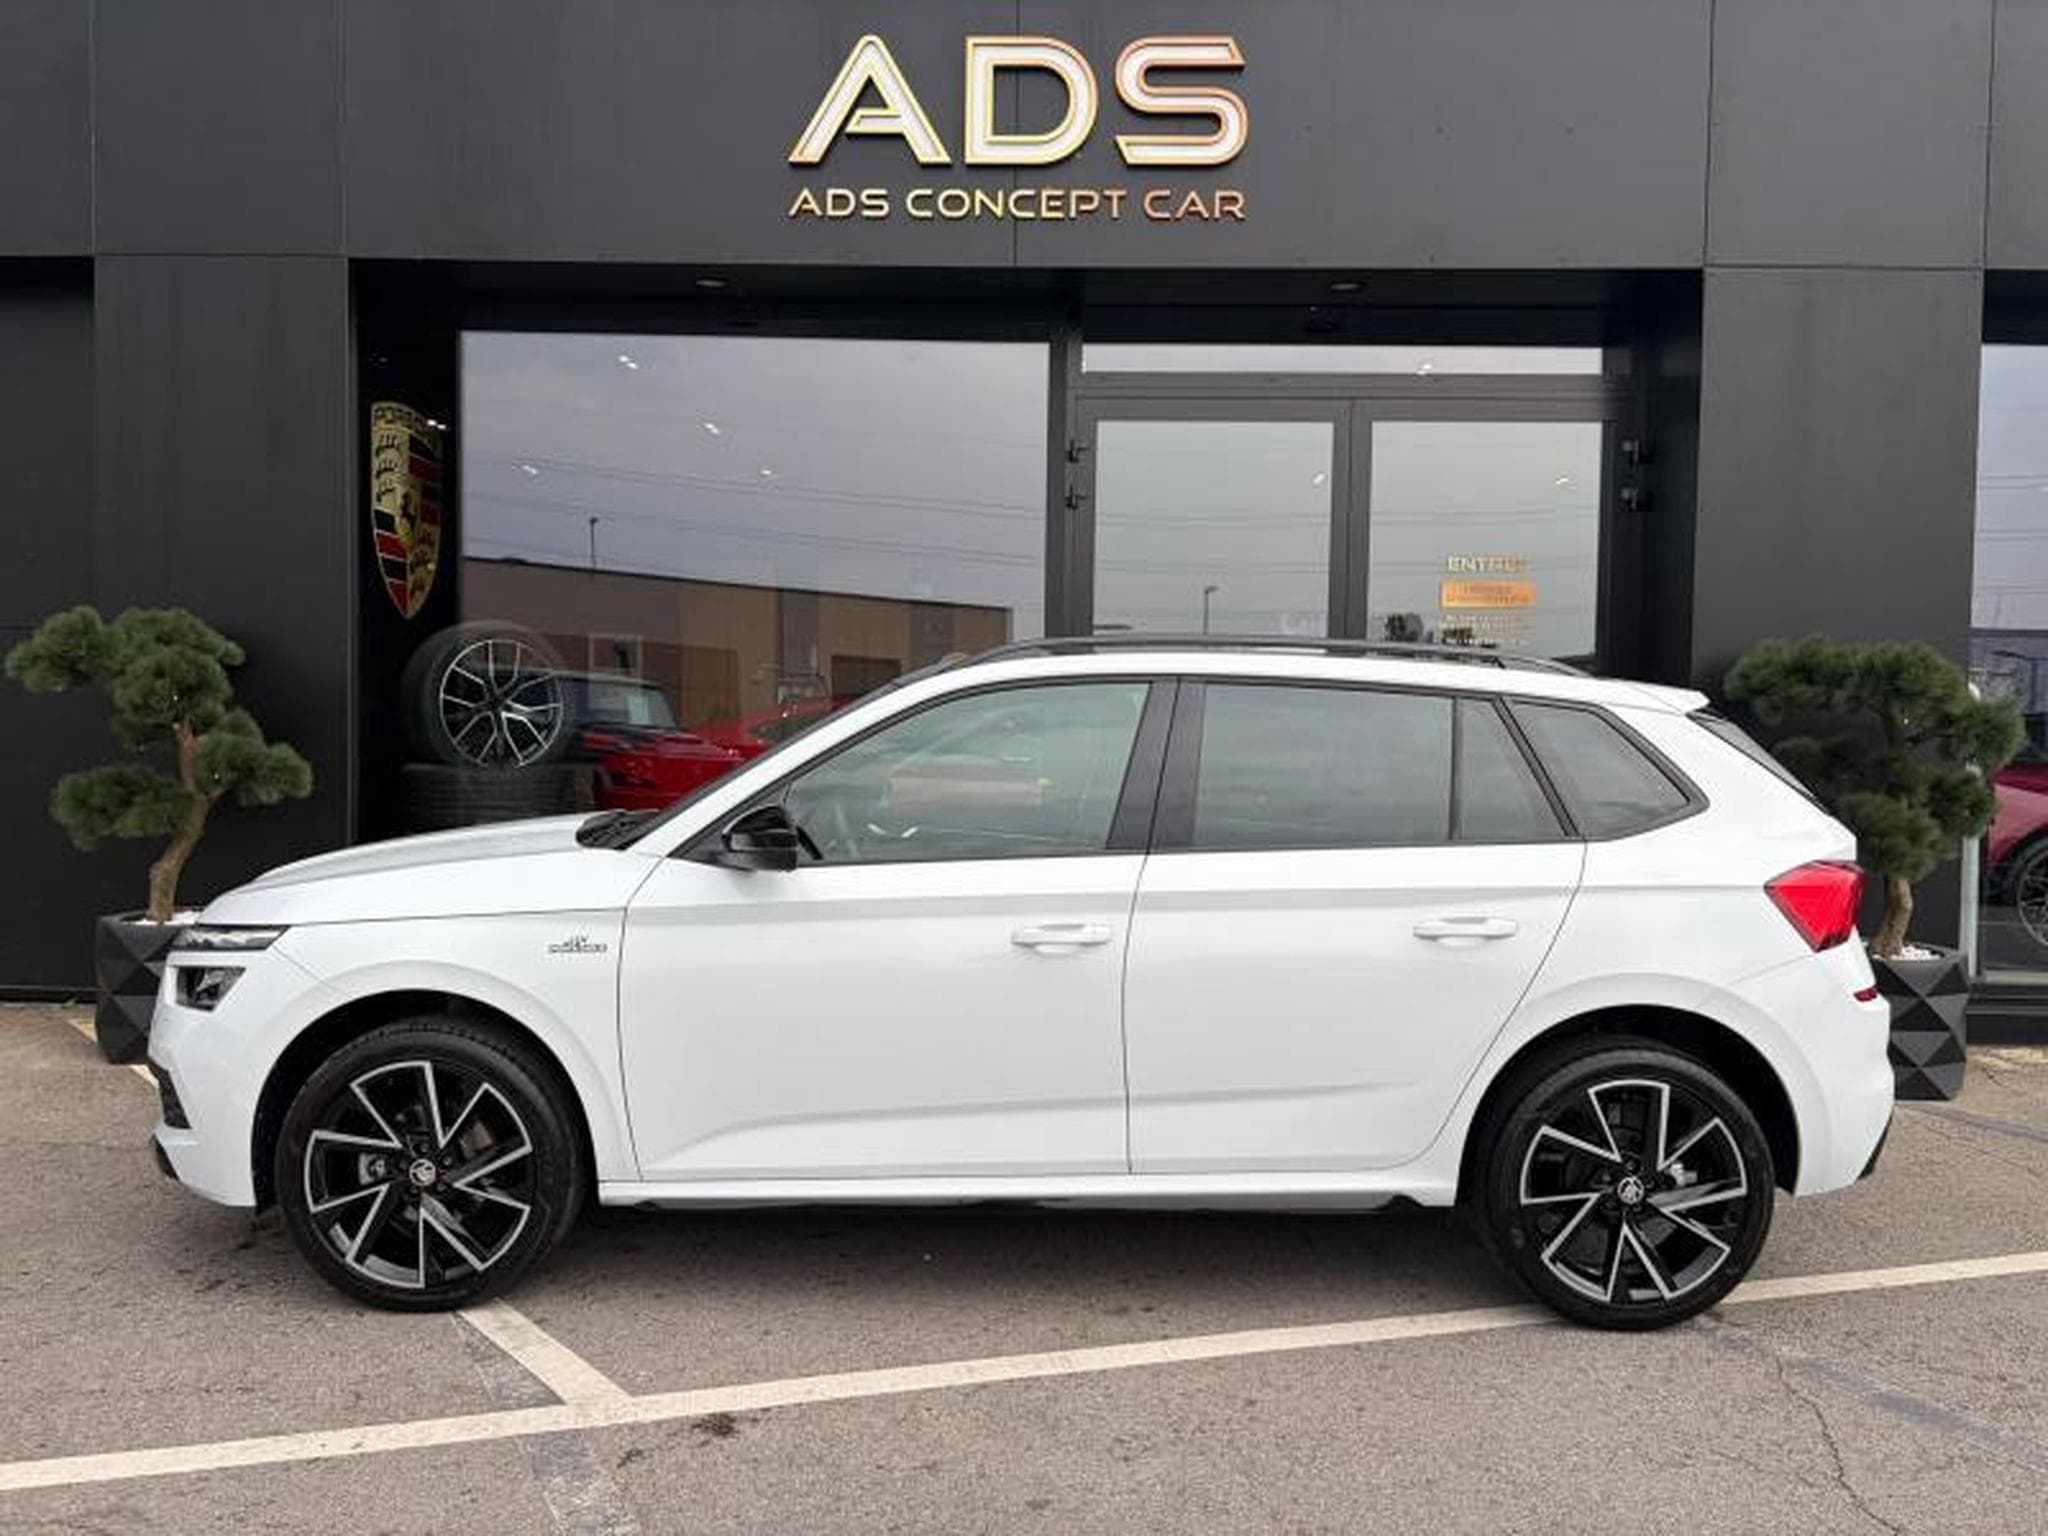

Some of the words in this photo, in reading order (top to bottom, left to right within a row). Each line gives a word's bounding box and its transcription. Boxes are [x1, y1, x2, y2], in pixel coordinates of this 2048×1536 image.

[787, 34, 1248, 165] ADS
[788, 187, 889, 217] ADS
[905, 187, 1127, 218] CONCEPT
[1143, 187, 1246, 219] CAR
